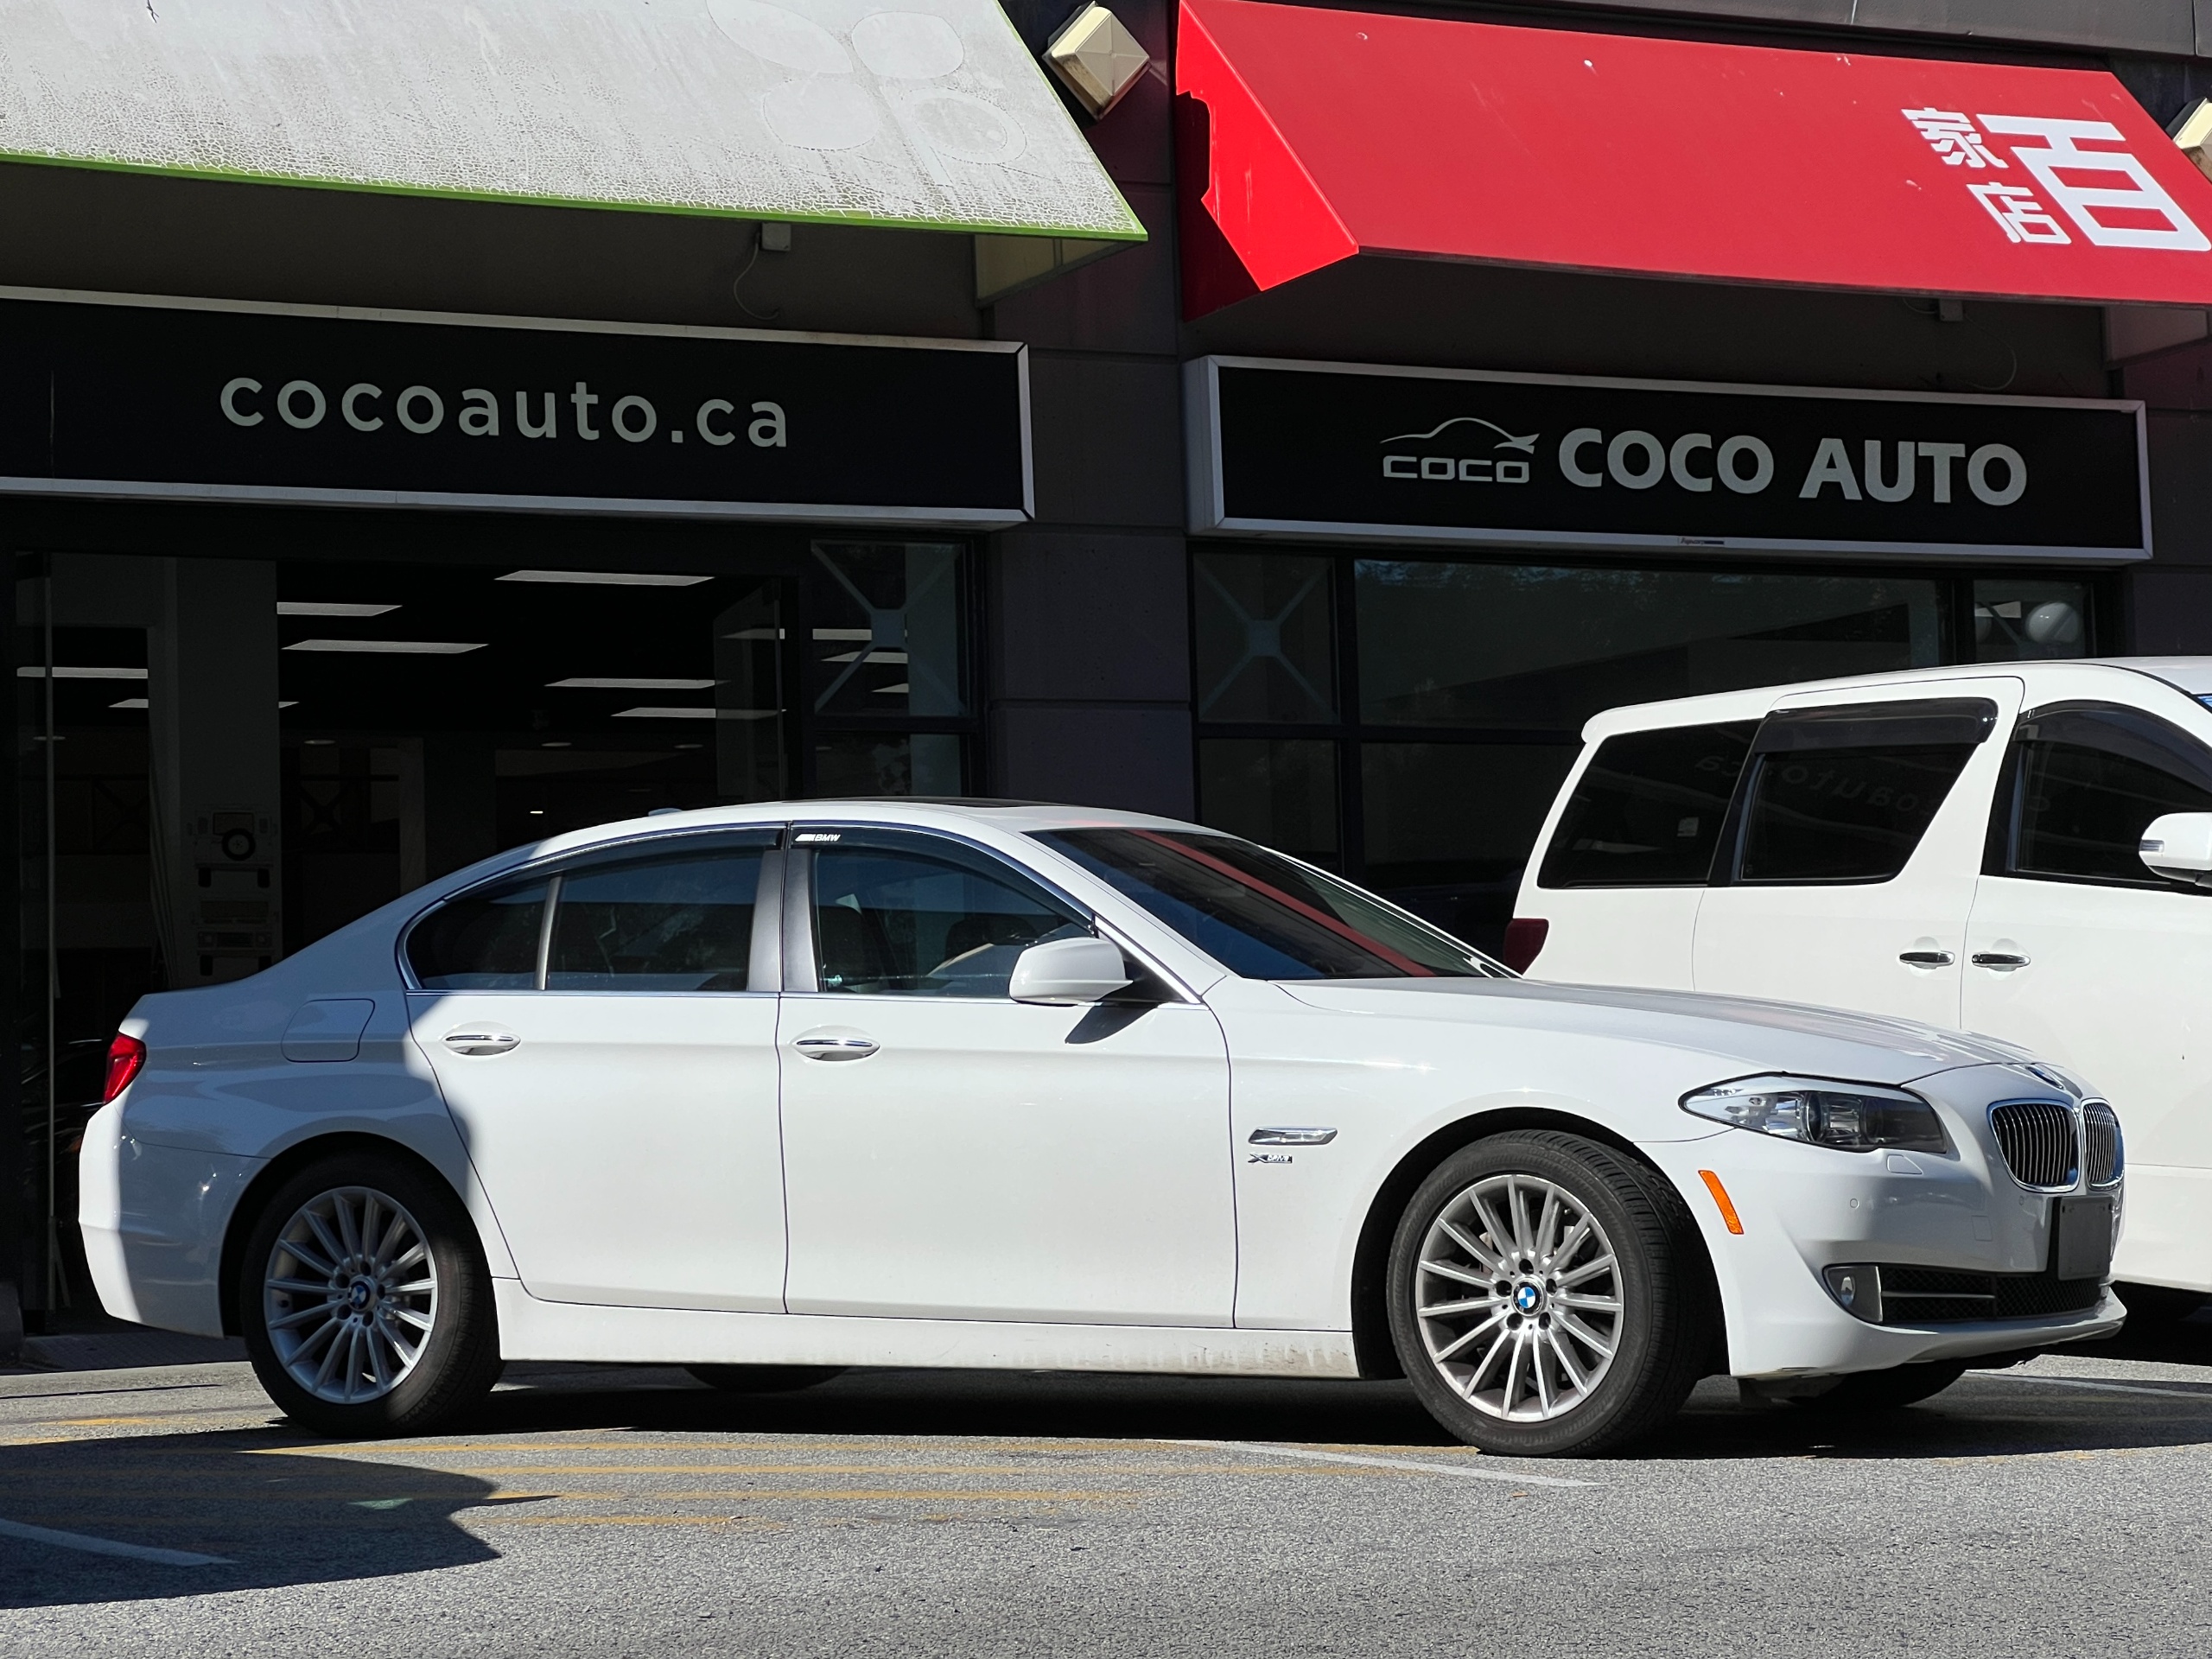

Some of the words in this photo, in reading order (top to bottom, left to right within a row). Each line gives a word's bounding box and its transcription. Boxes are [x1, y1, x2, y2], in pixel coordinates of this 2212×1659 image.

[1976, 114, 2212, 251] 百
[220, 377, 787, 448] cocoauto.ca
[1383, 455, 1529, 484] COCO
[1559, 428, 1774, 494] COCO
[1799, 437, 2027, 506] AUTO
